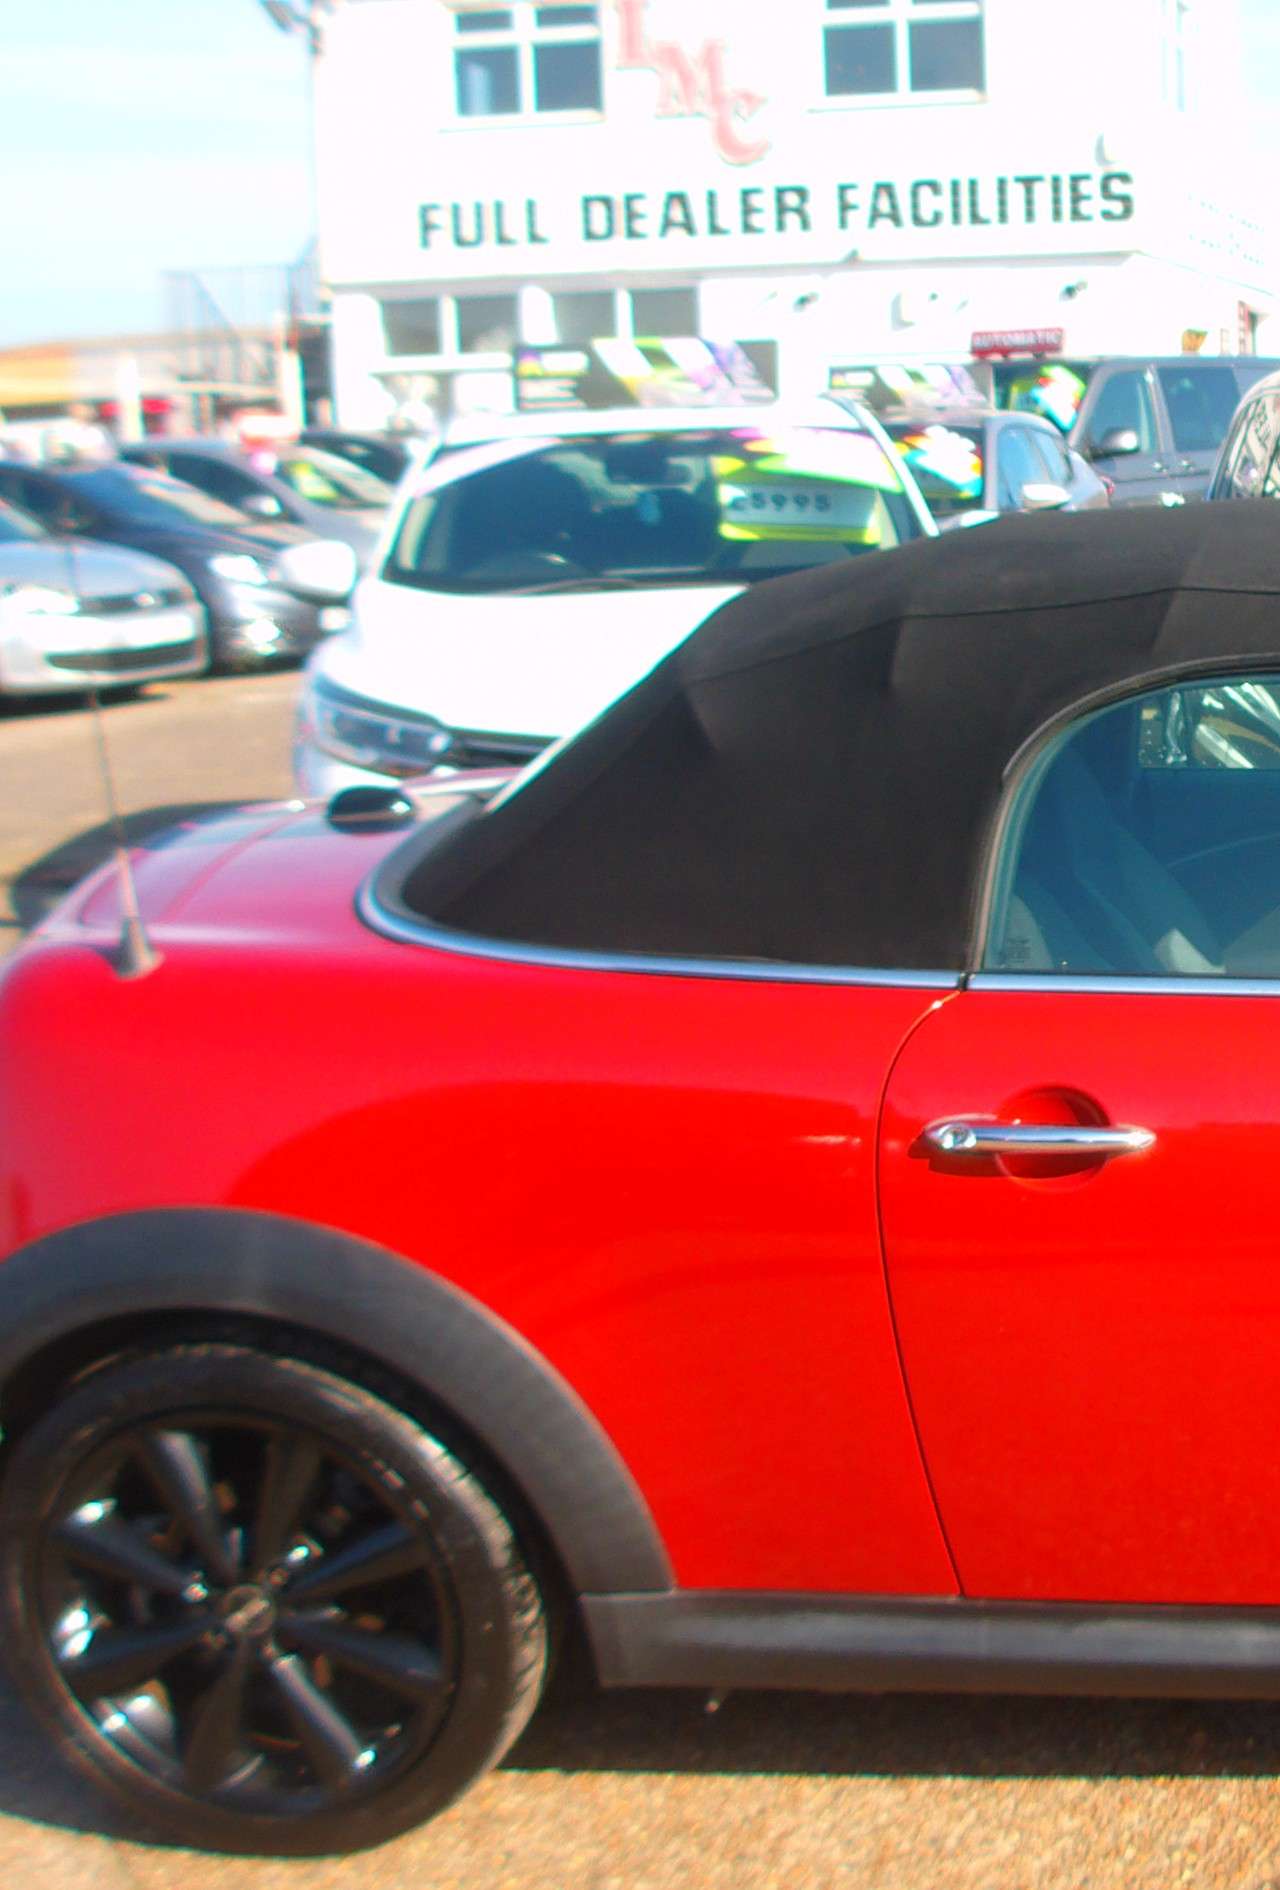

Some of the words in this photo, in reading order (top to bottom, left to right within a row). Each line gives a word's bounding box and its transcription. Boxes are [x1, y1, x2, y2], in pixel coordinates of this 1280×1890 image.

[418, 197, 550, 250] FULL
[581, 184, 812, 242] DEALER
[837, 171, 1135, 231] FACILITIES
